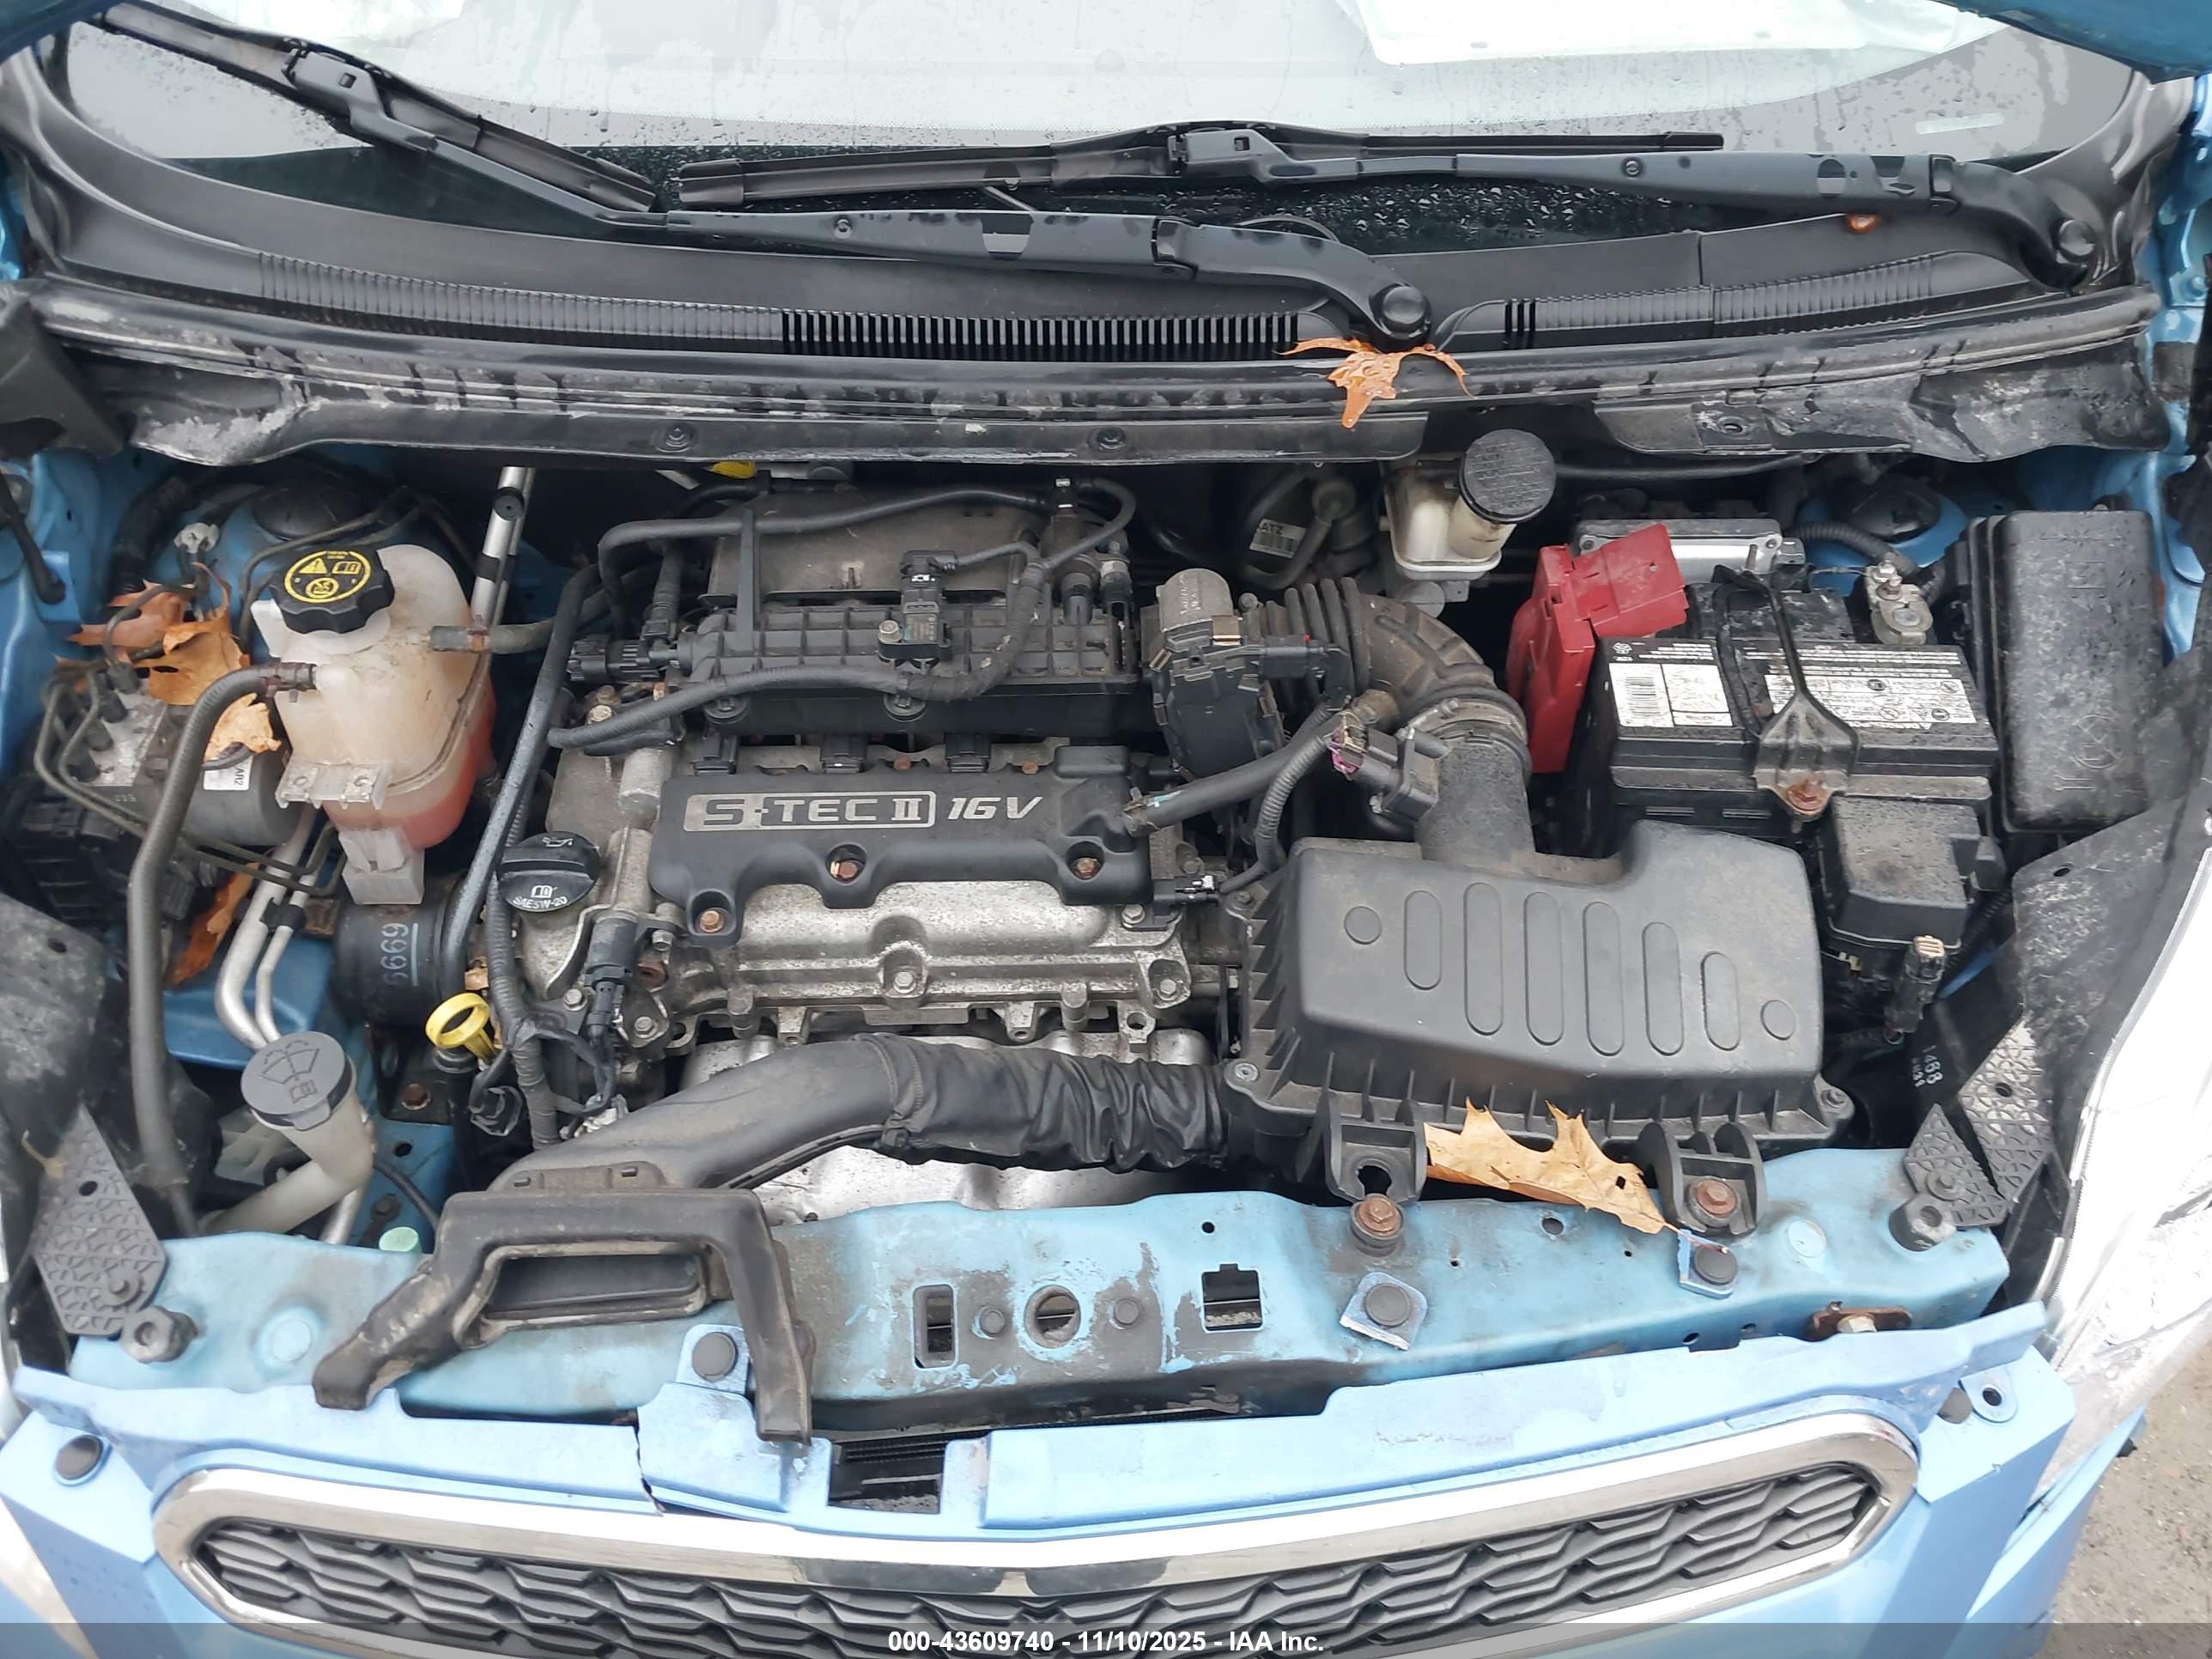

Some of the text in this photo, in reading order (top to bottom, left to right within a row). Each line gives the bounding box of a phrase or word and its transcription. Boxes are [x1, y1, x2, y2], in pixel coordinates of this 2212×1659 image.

[702, 795, 1043, 825] S-TEC II 16V
